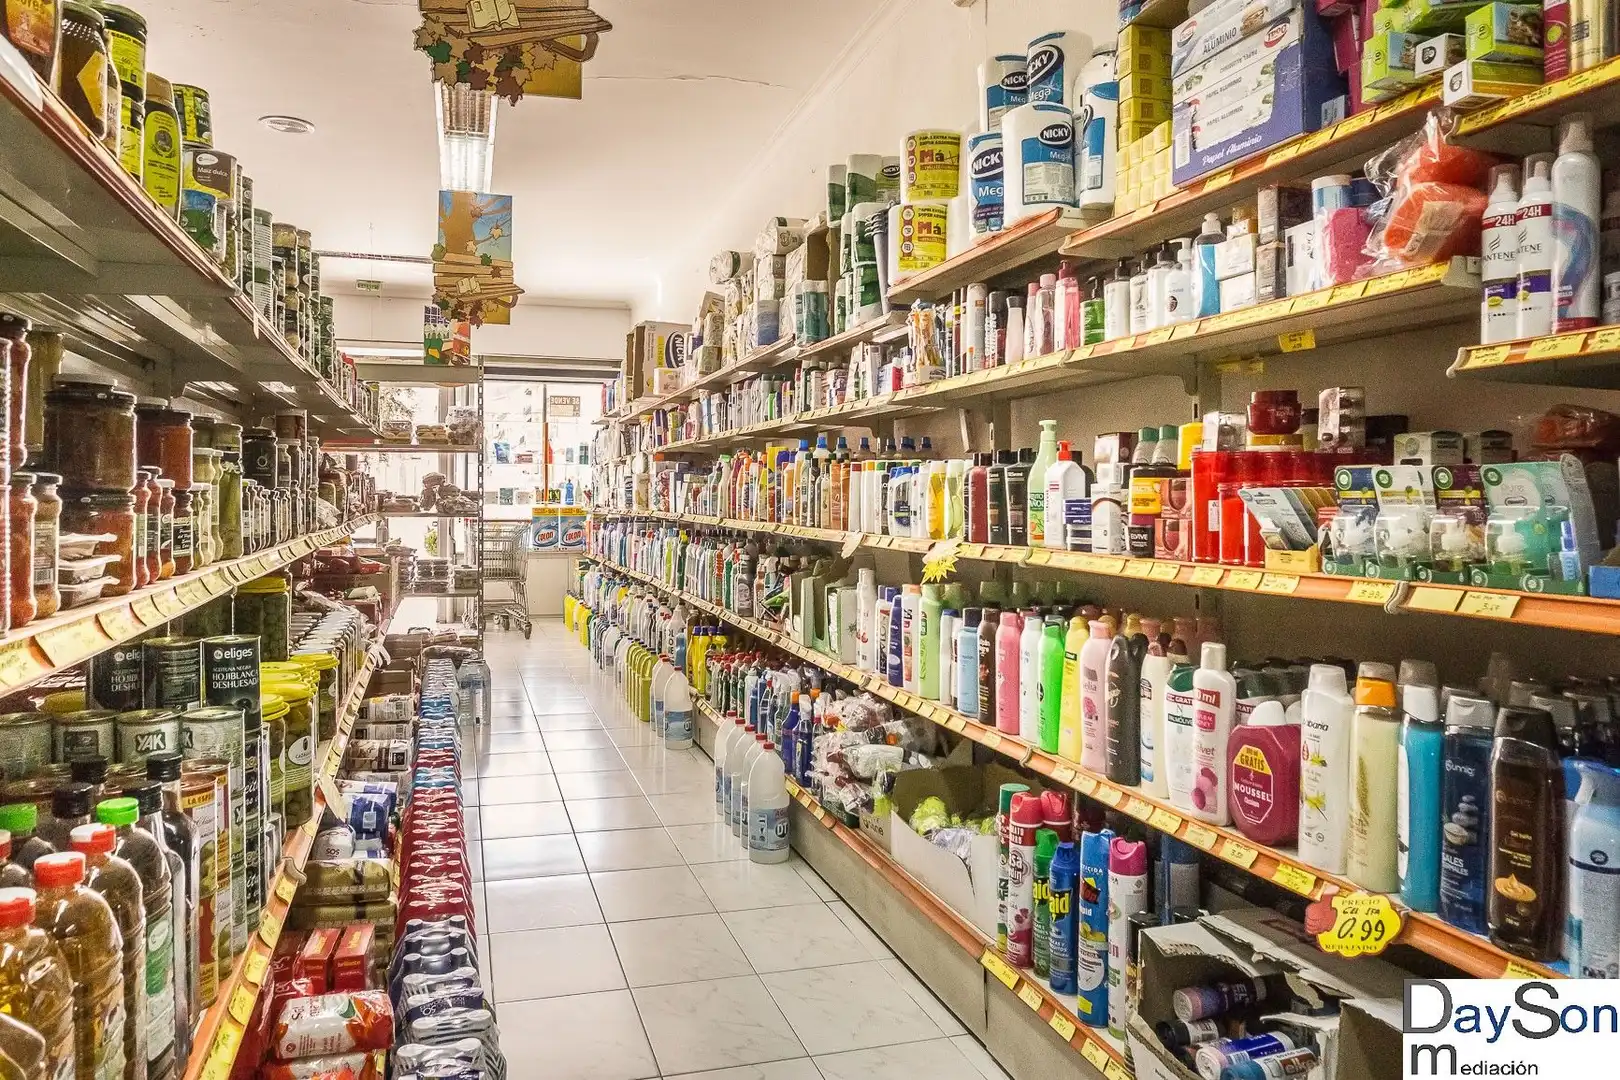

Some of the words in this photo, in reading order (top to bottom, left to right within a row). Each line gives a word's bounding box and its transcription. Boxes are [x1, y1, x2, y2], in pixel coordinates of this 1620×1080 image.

[1203, 27, 1237, 55] ALUMINIO
[1010, 95, 1026, 103] Meg
[1043, 128, 1069, 139] NICKY
[212, 168, 229, 178] dulce
[978, 186, 1004, 198] Meg
[1522, 206, 1541, 218] 24H
[1495, 216, 1515, 227] 24H
[126, 650, 141, 661] elig
[224, 649, 253, 661] eliges
[212, 678, 258, 689] DESHUESAD
[137, 733, 165, 751] YAK
[1240, 753, 1265, 771] GRATIS
[1234, 783, 1272, 802] MOUSSEL
[1033, 880, 1050, 900] aid
[1049, 893, 1070, 914] aid
[1337, 917, 1385, 942] 0.99
